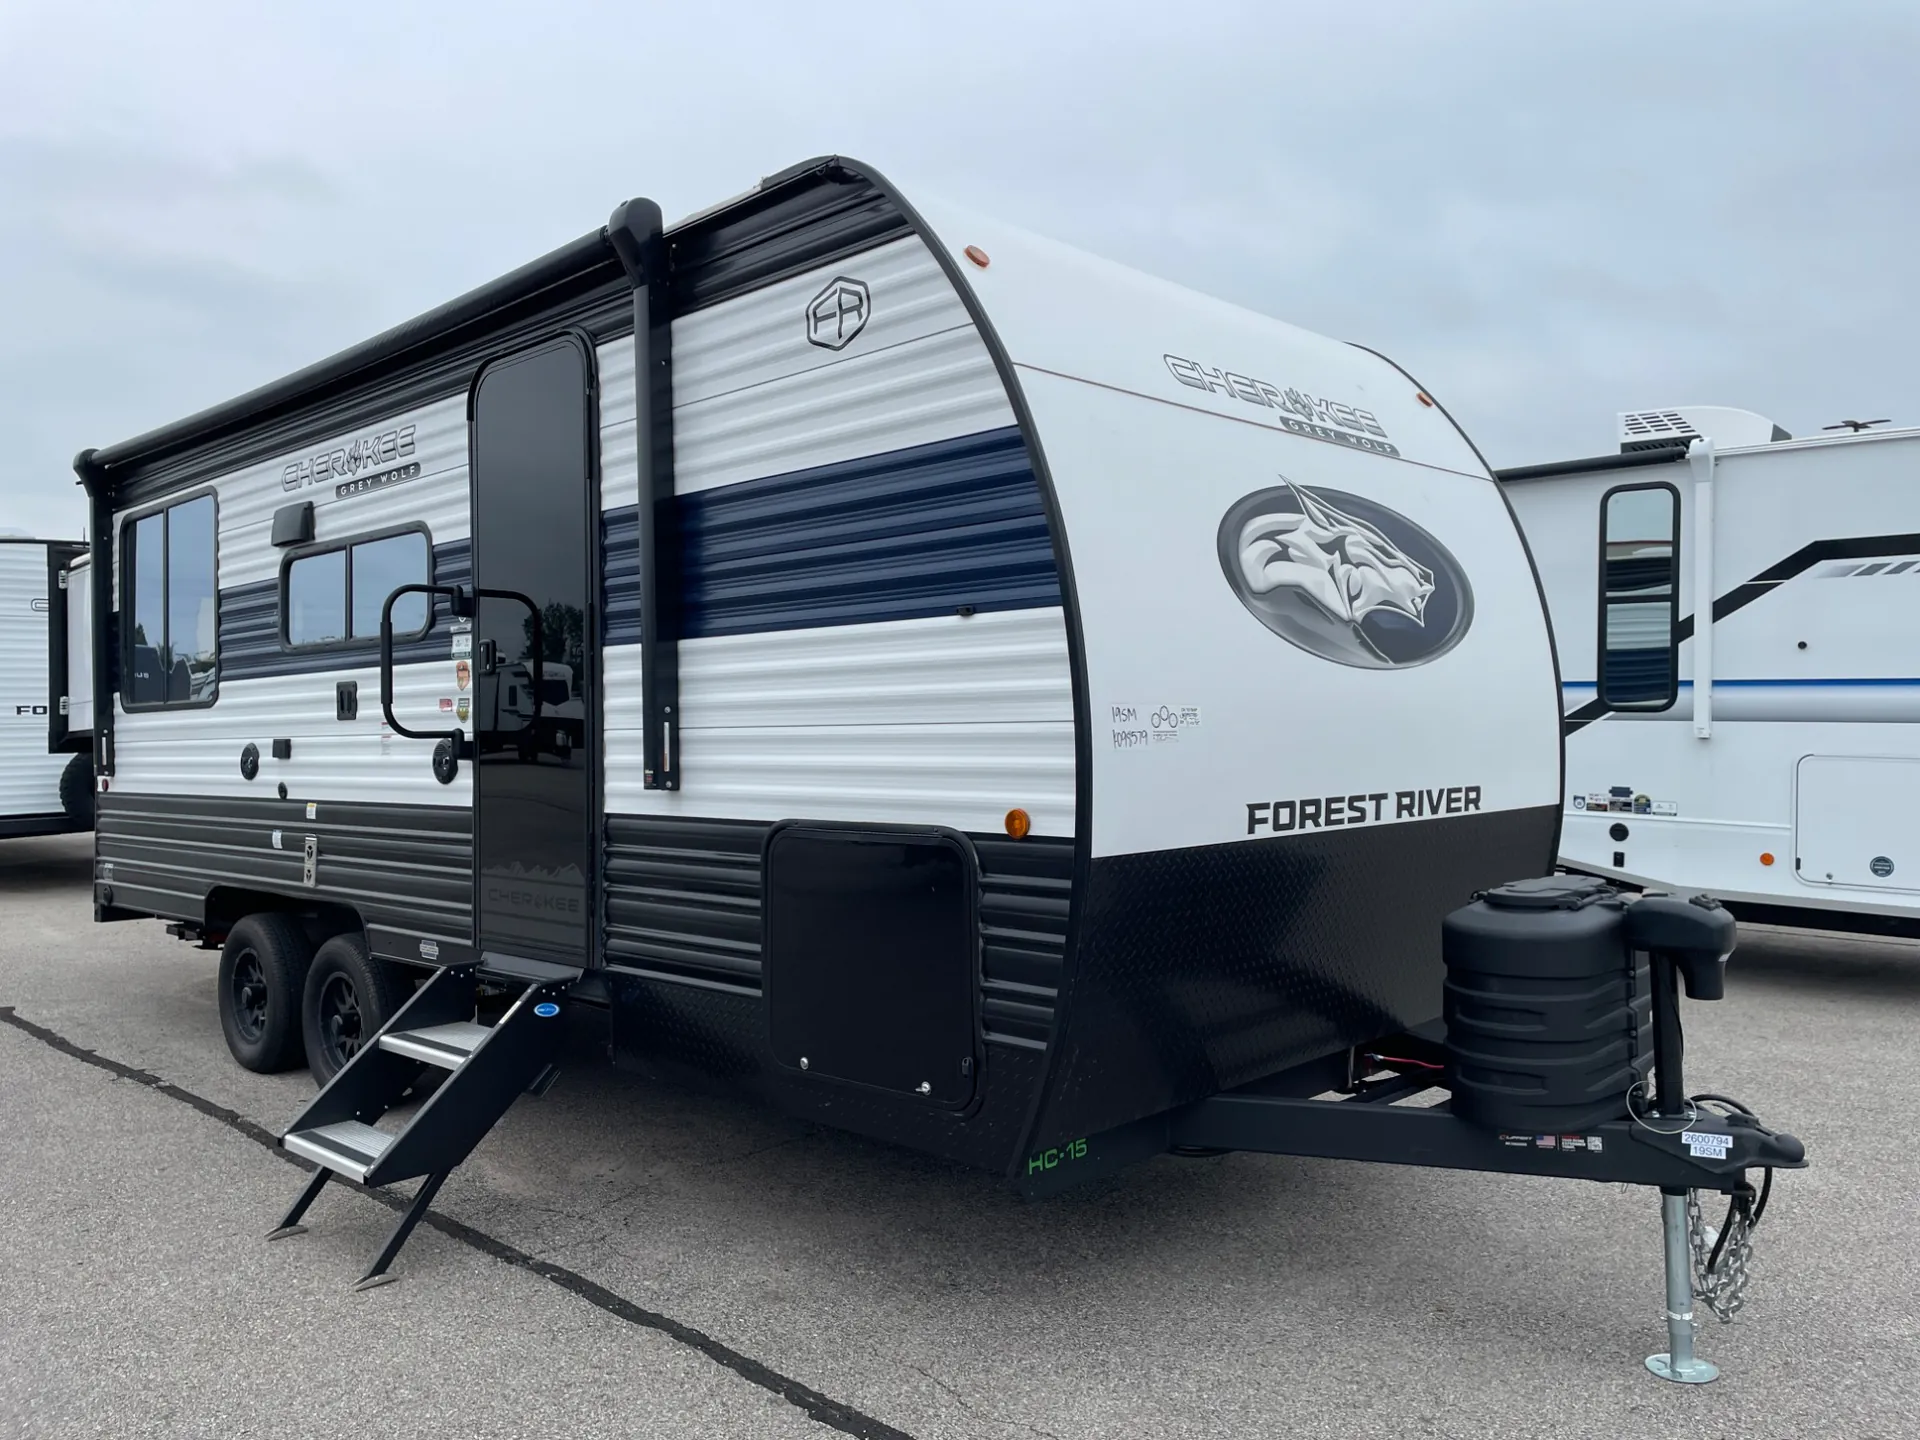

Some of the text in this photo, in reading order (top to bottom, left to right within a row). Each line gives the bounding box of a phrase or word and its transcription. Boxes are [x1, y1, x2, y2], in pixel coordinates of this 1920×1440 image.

[1163, 353, 1389, 439] CHEROKEE
[1288, 419, 1393, 454] GREY WOLF
[281, 424, 416, 493] CHEROKEE
[340, 465, 417, 496] GREY WOLF
[1246, 785, 1482, 835] FOREST RIVER
[1684, 1133, 1729, 1146] 2600794
[1693, 1146, 1723, 1157] 19SM
